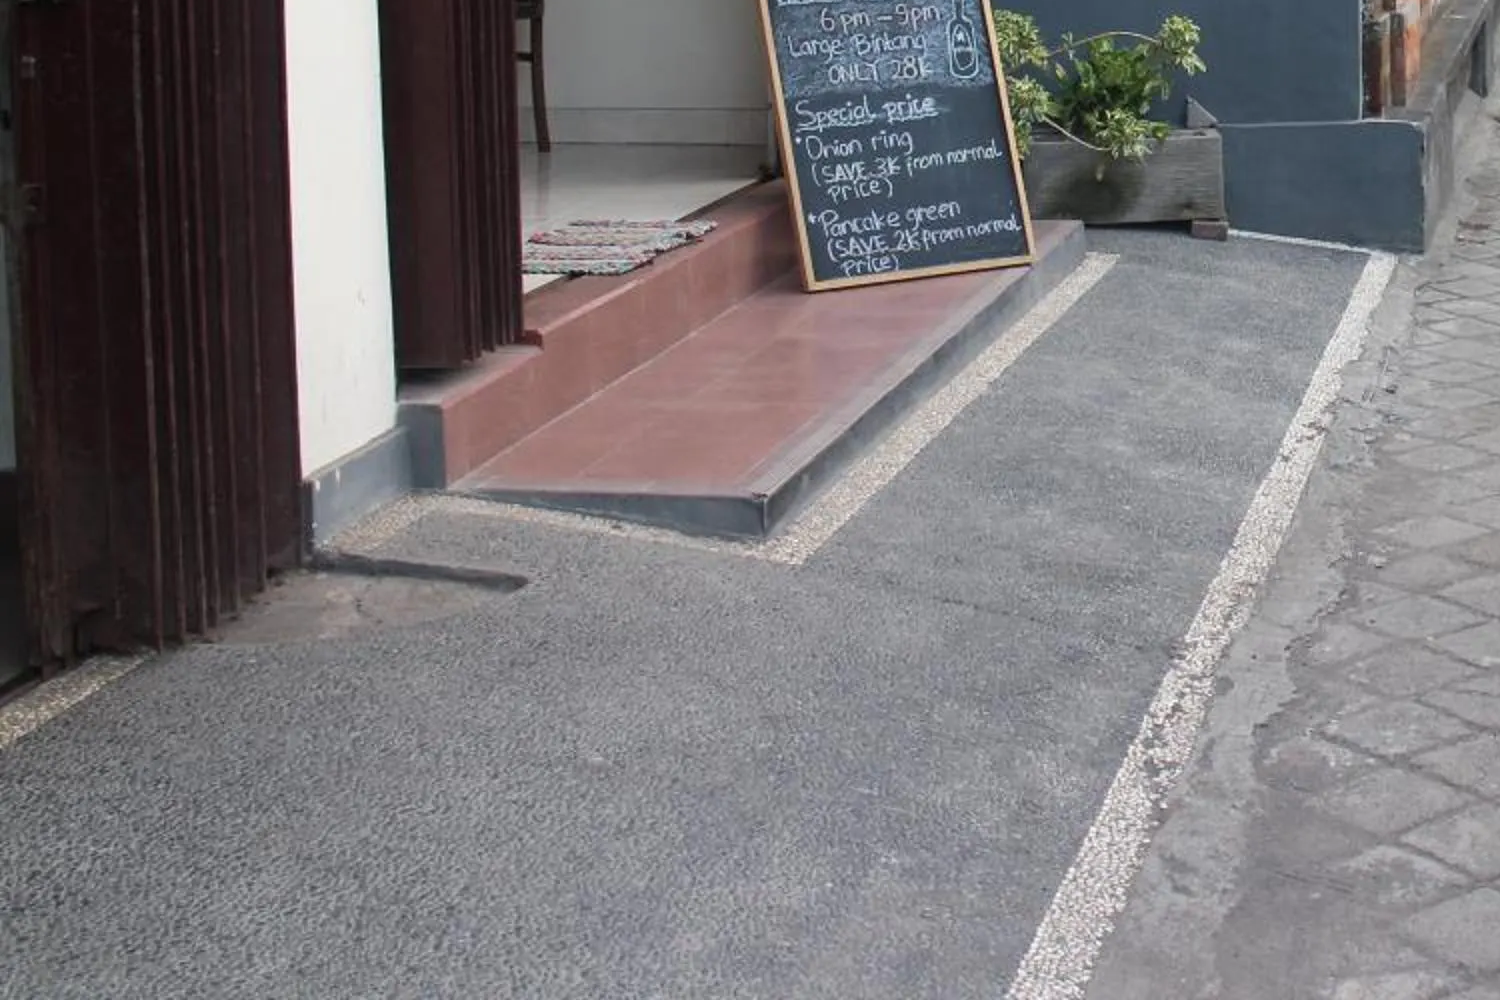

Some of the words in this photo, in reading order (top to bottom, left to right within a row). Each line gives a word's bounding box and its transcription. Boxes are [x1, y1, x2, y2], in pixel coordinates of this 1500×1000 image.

[821, 7, 835, 32] 6
[895, 4, 940, 30] 9pm
[786, 34, 843, 64] Large
[851, 31, 927, 57] Bintang
[828, 59, 880, 84] ONLY
[794, 95, 877, 131] Special
[882, 94, 942, 123] price
[805, 135, 862, 160] Onion
[871, 130, 913, 156] ring
[811, 161, 866, 187] (SAVE
[906, 151, 944, 178] from
[947, 138, 1003, 164] normal
[827, 178, 893, 204] price)
[819, 208, 901, 238] Pancake
[905, 201, 962, 231] green
[827, 235, 889, 262] (SAVE
[922, 226, 965, 250] from
[967, 213, 1023, 238] normal
[840, 255, 899, 277] price)
